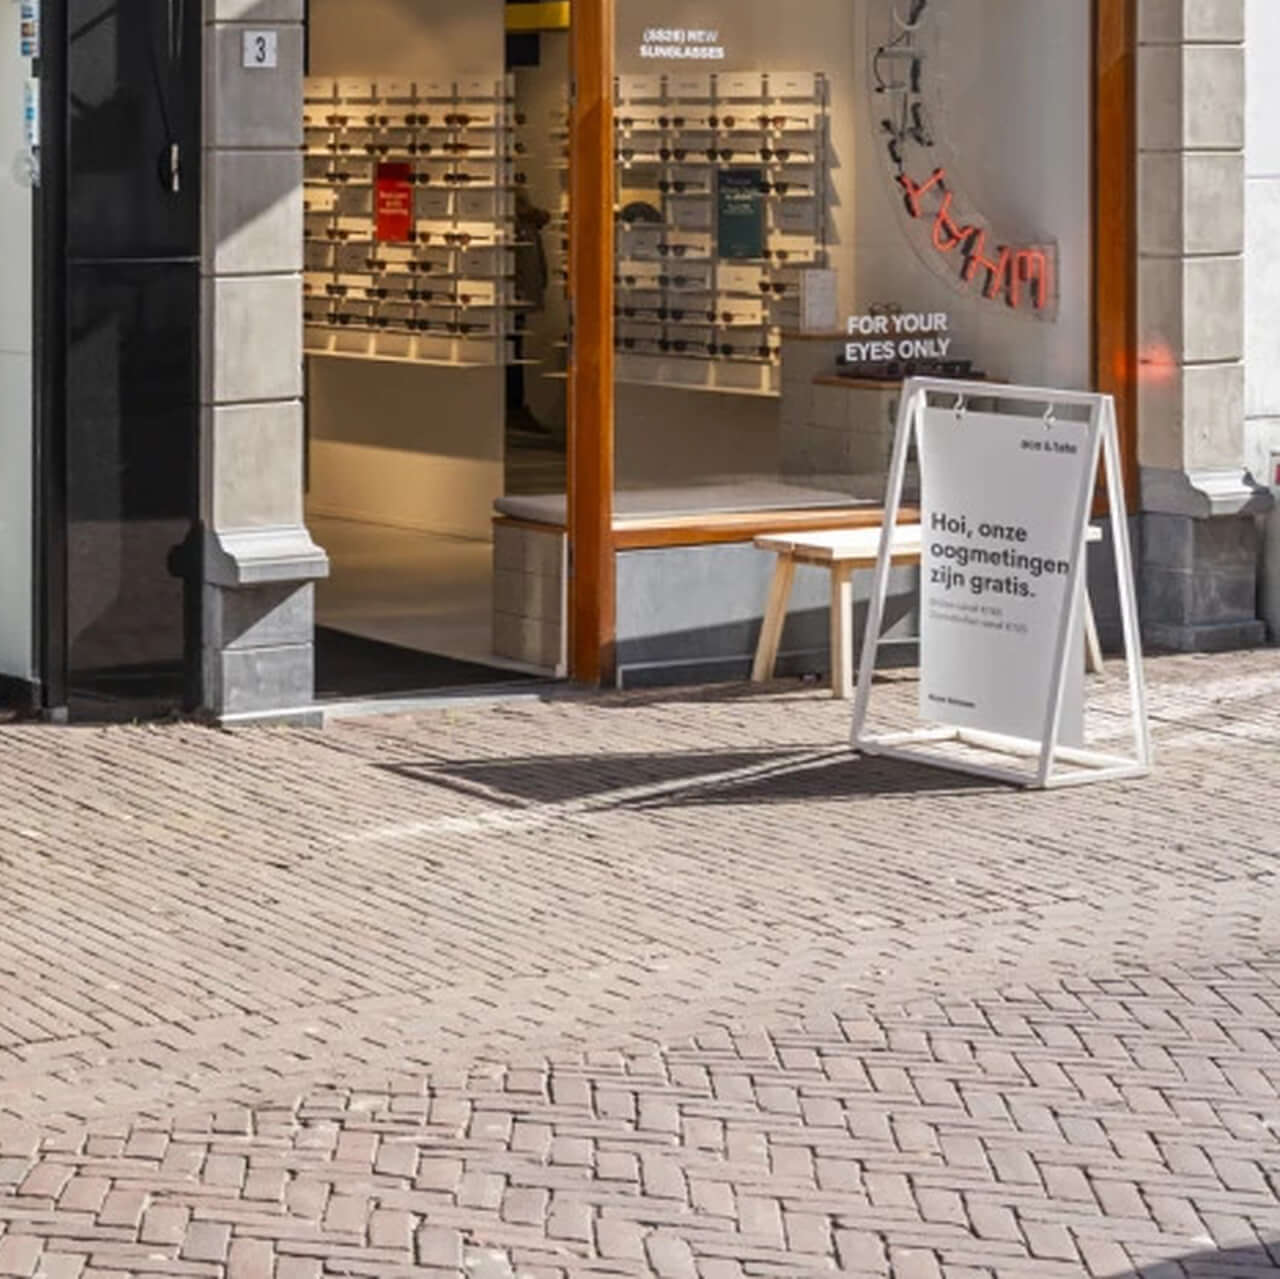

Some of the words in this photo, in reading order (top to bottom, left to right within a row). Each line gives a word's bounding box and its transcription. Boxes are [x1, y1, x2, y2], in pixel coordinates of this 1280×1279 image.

[255, 35, 267, 63] 3
[639, 44, 725, 59] SUNGLASSES
[847, 315, 889, 335] FOR
[891, 312, 948, 334] YOUR
[845, 340, 896, 361] EYES
[898, 337, 951, 360] ONLY
[930, 512, 973, 540] Hoi,
[978, 522, 1028, 542] onze
[930, 542, 1070, 577] oogmetingen
[930, 565, 966, 591] zijn
[970, 575, 1037, 598] gratis.
